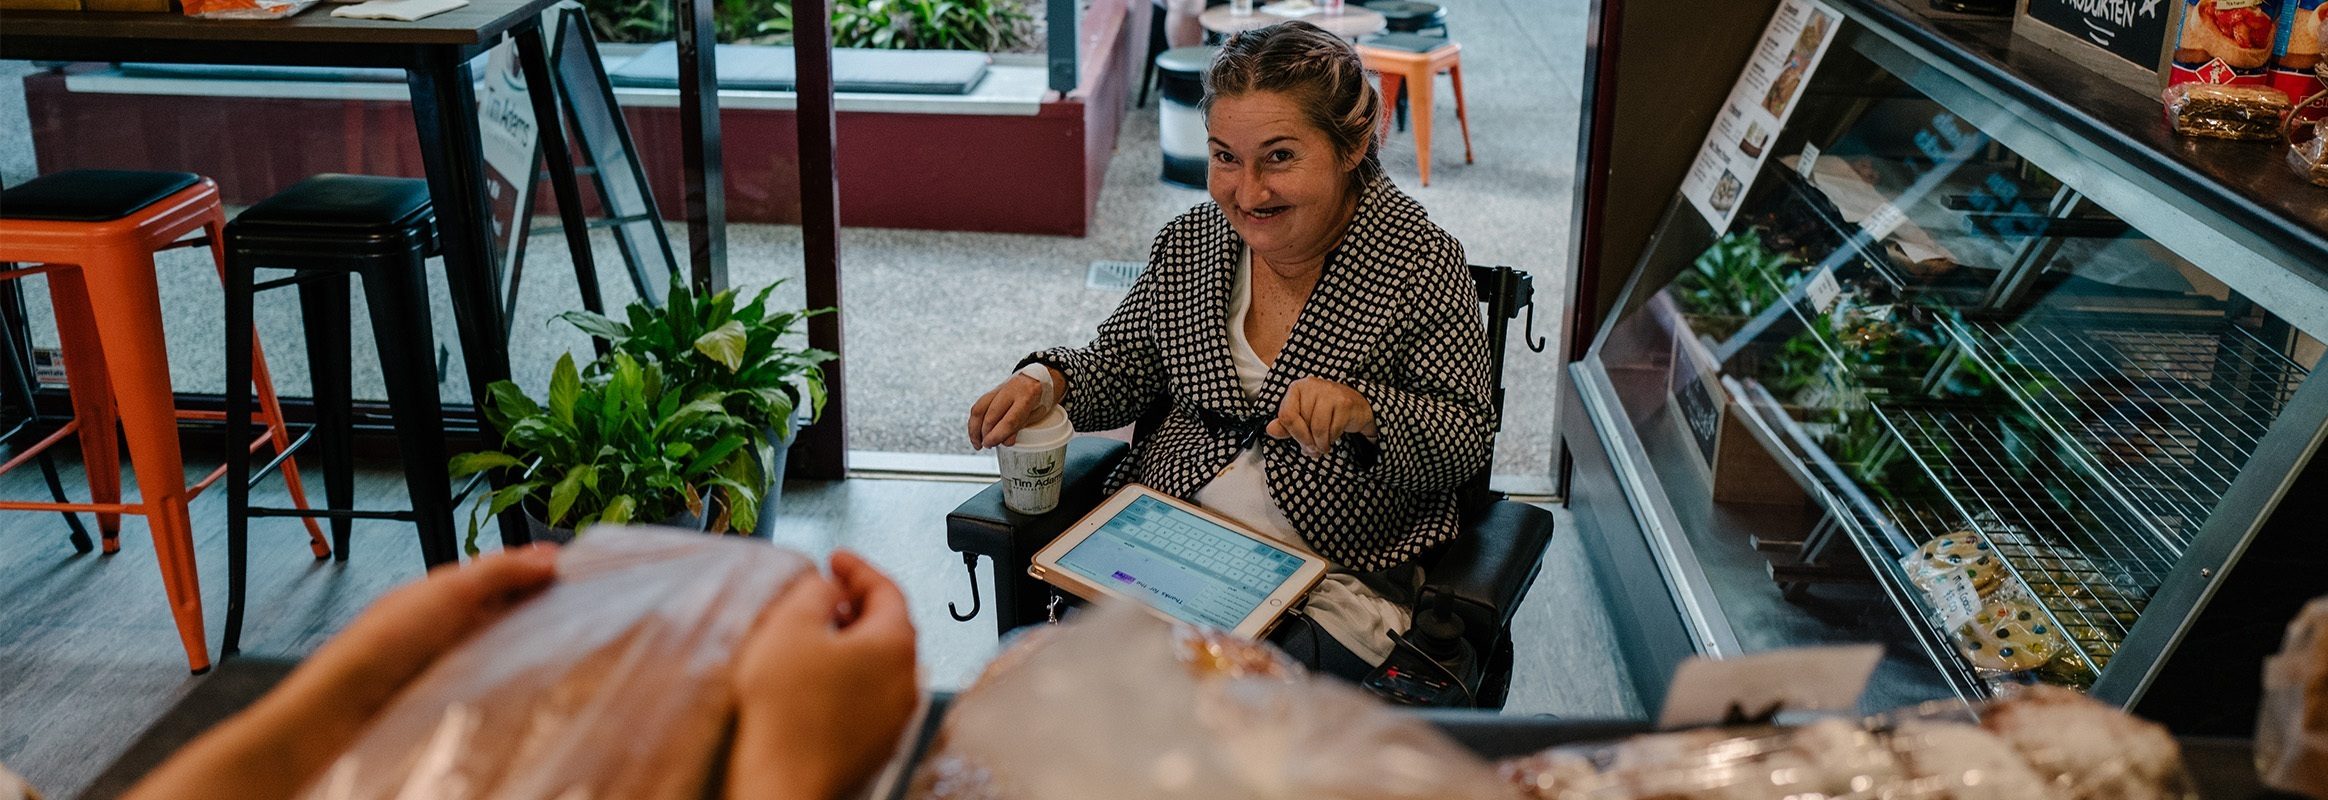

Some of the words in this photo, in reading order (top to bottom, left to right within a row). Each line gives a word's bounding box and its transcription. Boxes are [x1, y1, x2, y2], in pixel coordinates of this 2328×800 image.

[2062, 0, 2136, 28] DUKTEN
[1012, 477, 1032, 488] Tim
[1136, 580, 1148, 589] the
[1149, 586, 1160, 594] for
[1161, 591, 1183, 604] Thanks
